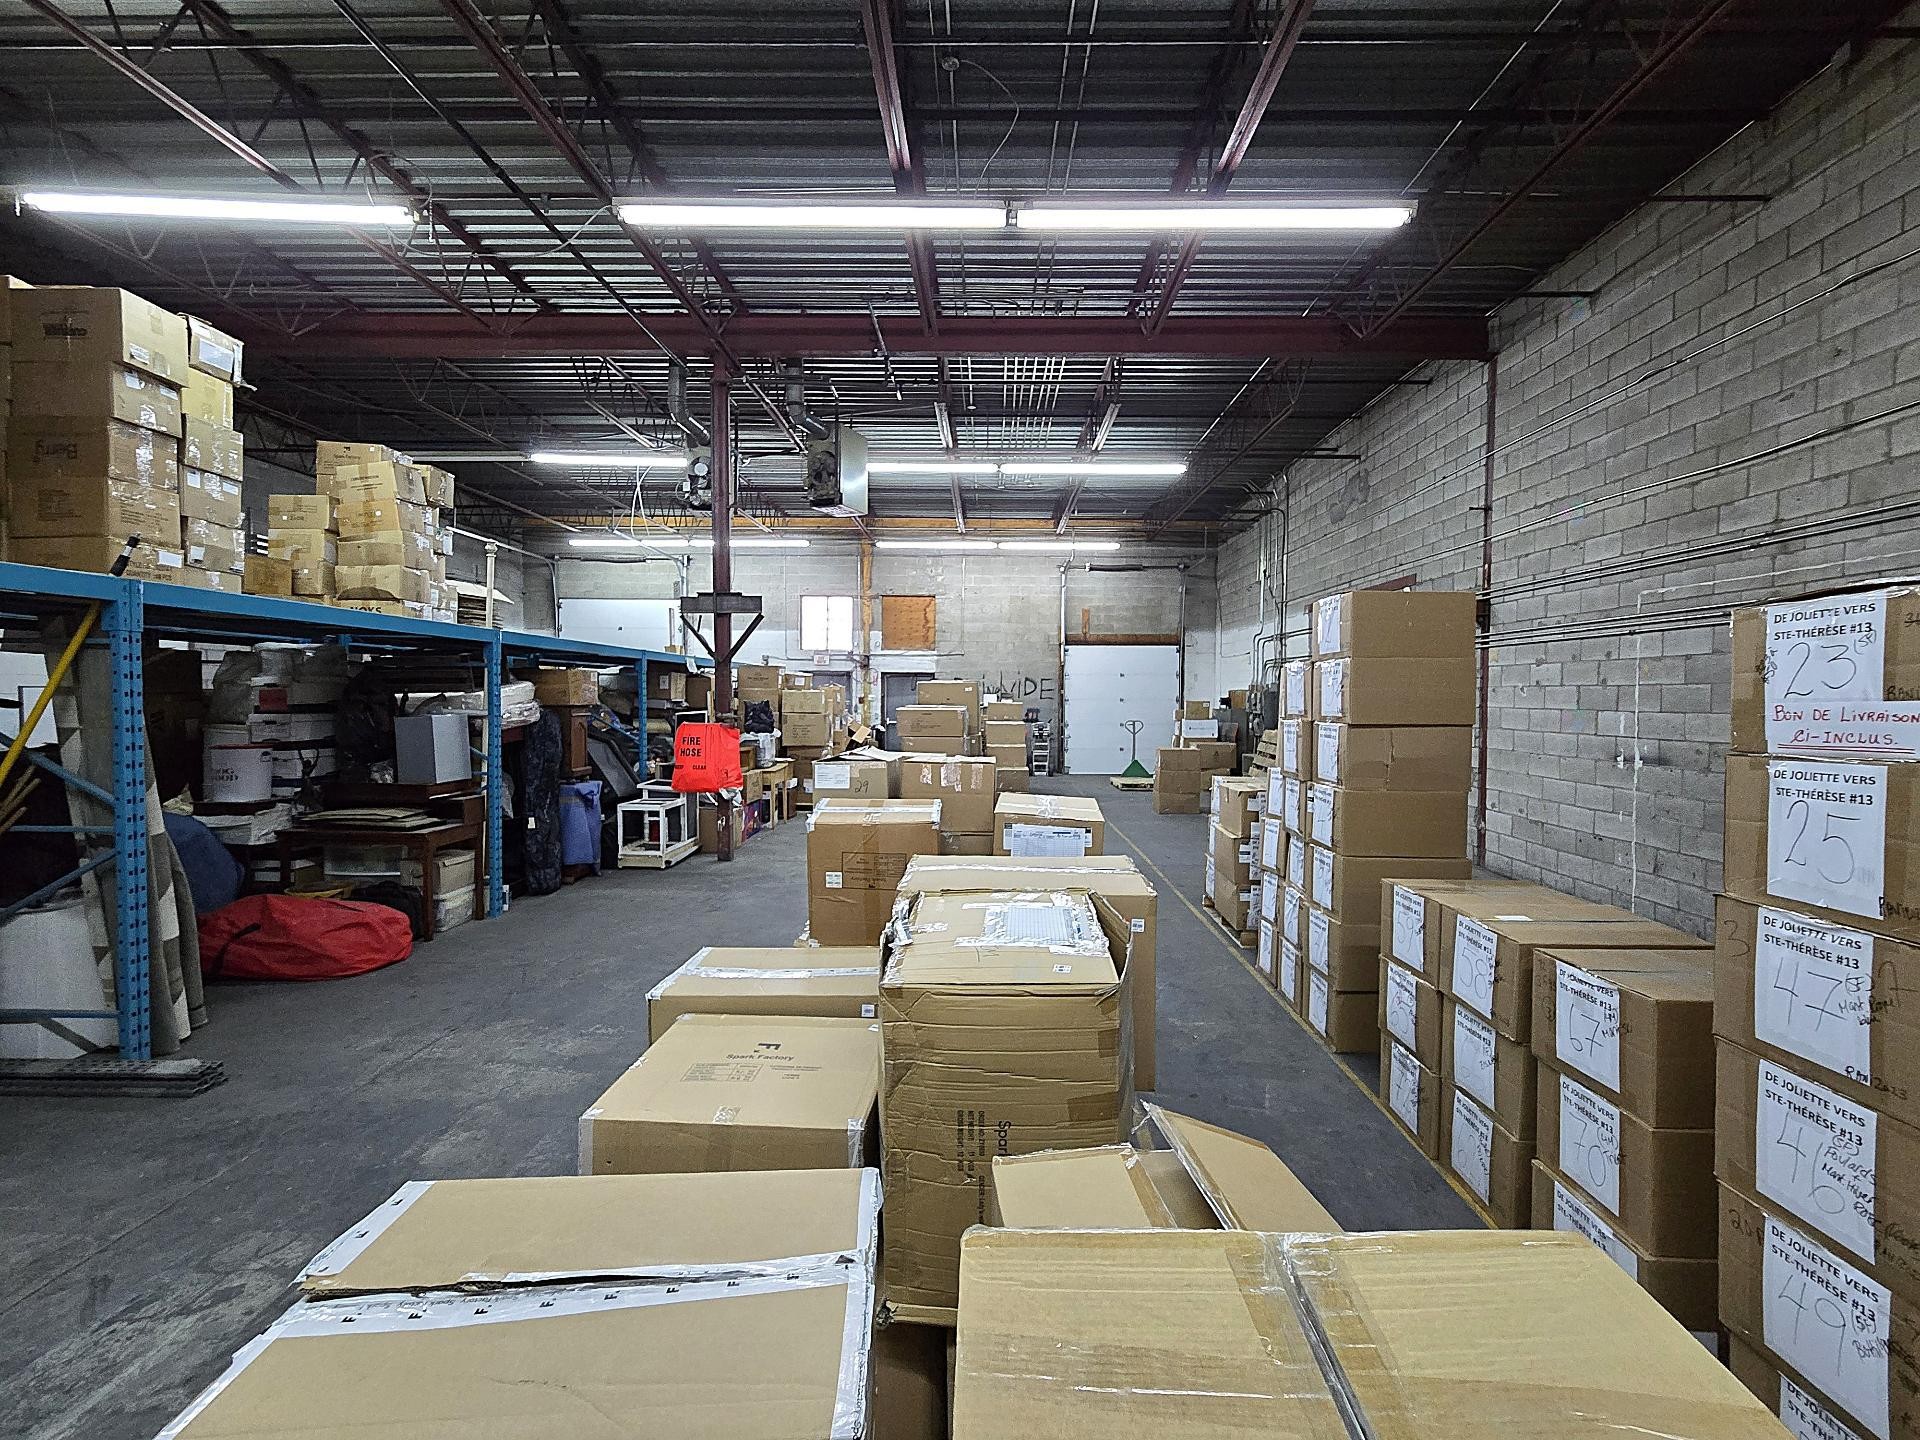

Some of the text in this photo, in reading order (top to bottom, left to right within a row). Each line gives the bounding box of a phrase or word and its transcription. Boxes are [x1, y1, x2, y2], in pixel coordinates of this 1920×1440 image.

[1774, 603, 1876, 624] DE JOLIETTE VERS
[1774, 622, 1873, 641] STE-THÉRÈSE #13
[1784, 642, 1857, 699] 23
[1812, 708, 1831, 721] DE
[680, 747, 702, 757] HOSE
[682, 736, 701, 746] FIRE
[854, 780, 869, 793] 29
[1774, 769, 1876, 786] DE JOLIETTE VERS
[1776, 786, 1873, 806] STE-THÉRÈSE #13
[1785, 800, 1861, 885] 25
[1763, 915, 1862, 950] DE JOLIETTE VERS
[1763, 933, 1860, 970] STE-THÉRÈSE #13
[1459, 946, 1488, 1000] 58
[1773, 957, 1848, 1032] 47
[1569, 1003, 1604, 1058] 67
[757, 1053, 795, 1062] Factory
[1765, 1070, 1866, 1128] DE JOLIETTE VERS
[1765, 1089, 1863, 1147] STE-THÉRÈSE #13
[1569, 1111, 1607, 1187] 70
[1776, 1112, 1846, 1214] 46
[1771, 1225, 1786, 1242] DE
[1787, 1234, 1841, 1280] JOLIETTE
[1843, 1271, 1879, 1304] VERS
[1771, 1244, 1876, 1322] STE-THÉRÈSE #13
[1778, 1274, 1847, 1377] 49
[1787, 1381, 1802, 1402] DE
